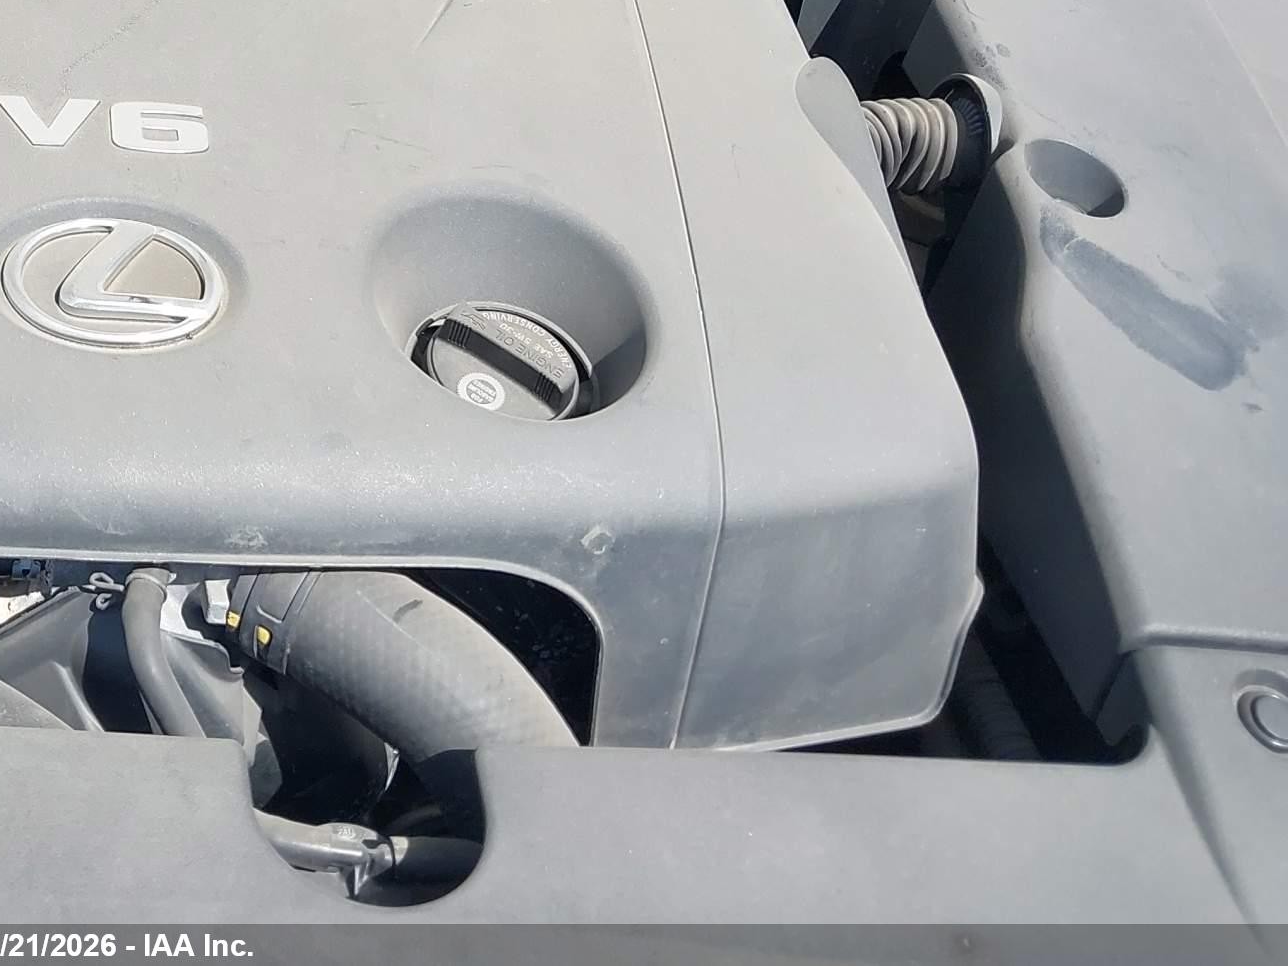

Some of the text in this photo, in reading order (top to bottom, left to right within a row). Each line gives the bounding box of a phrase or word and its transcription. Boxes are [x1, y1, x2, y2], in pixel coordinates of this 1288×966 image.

[482, 311, 573, 369] ENERGY CONSERVING
[495, 329, 565, 379] ENGINE OIL
[499, 323, 554, 359] SAE 5W-30
